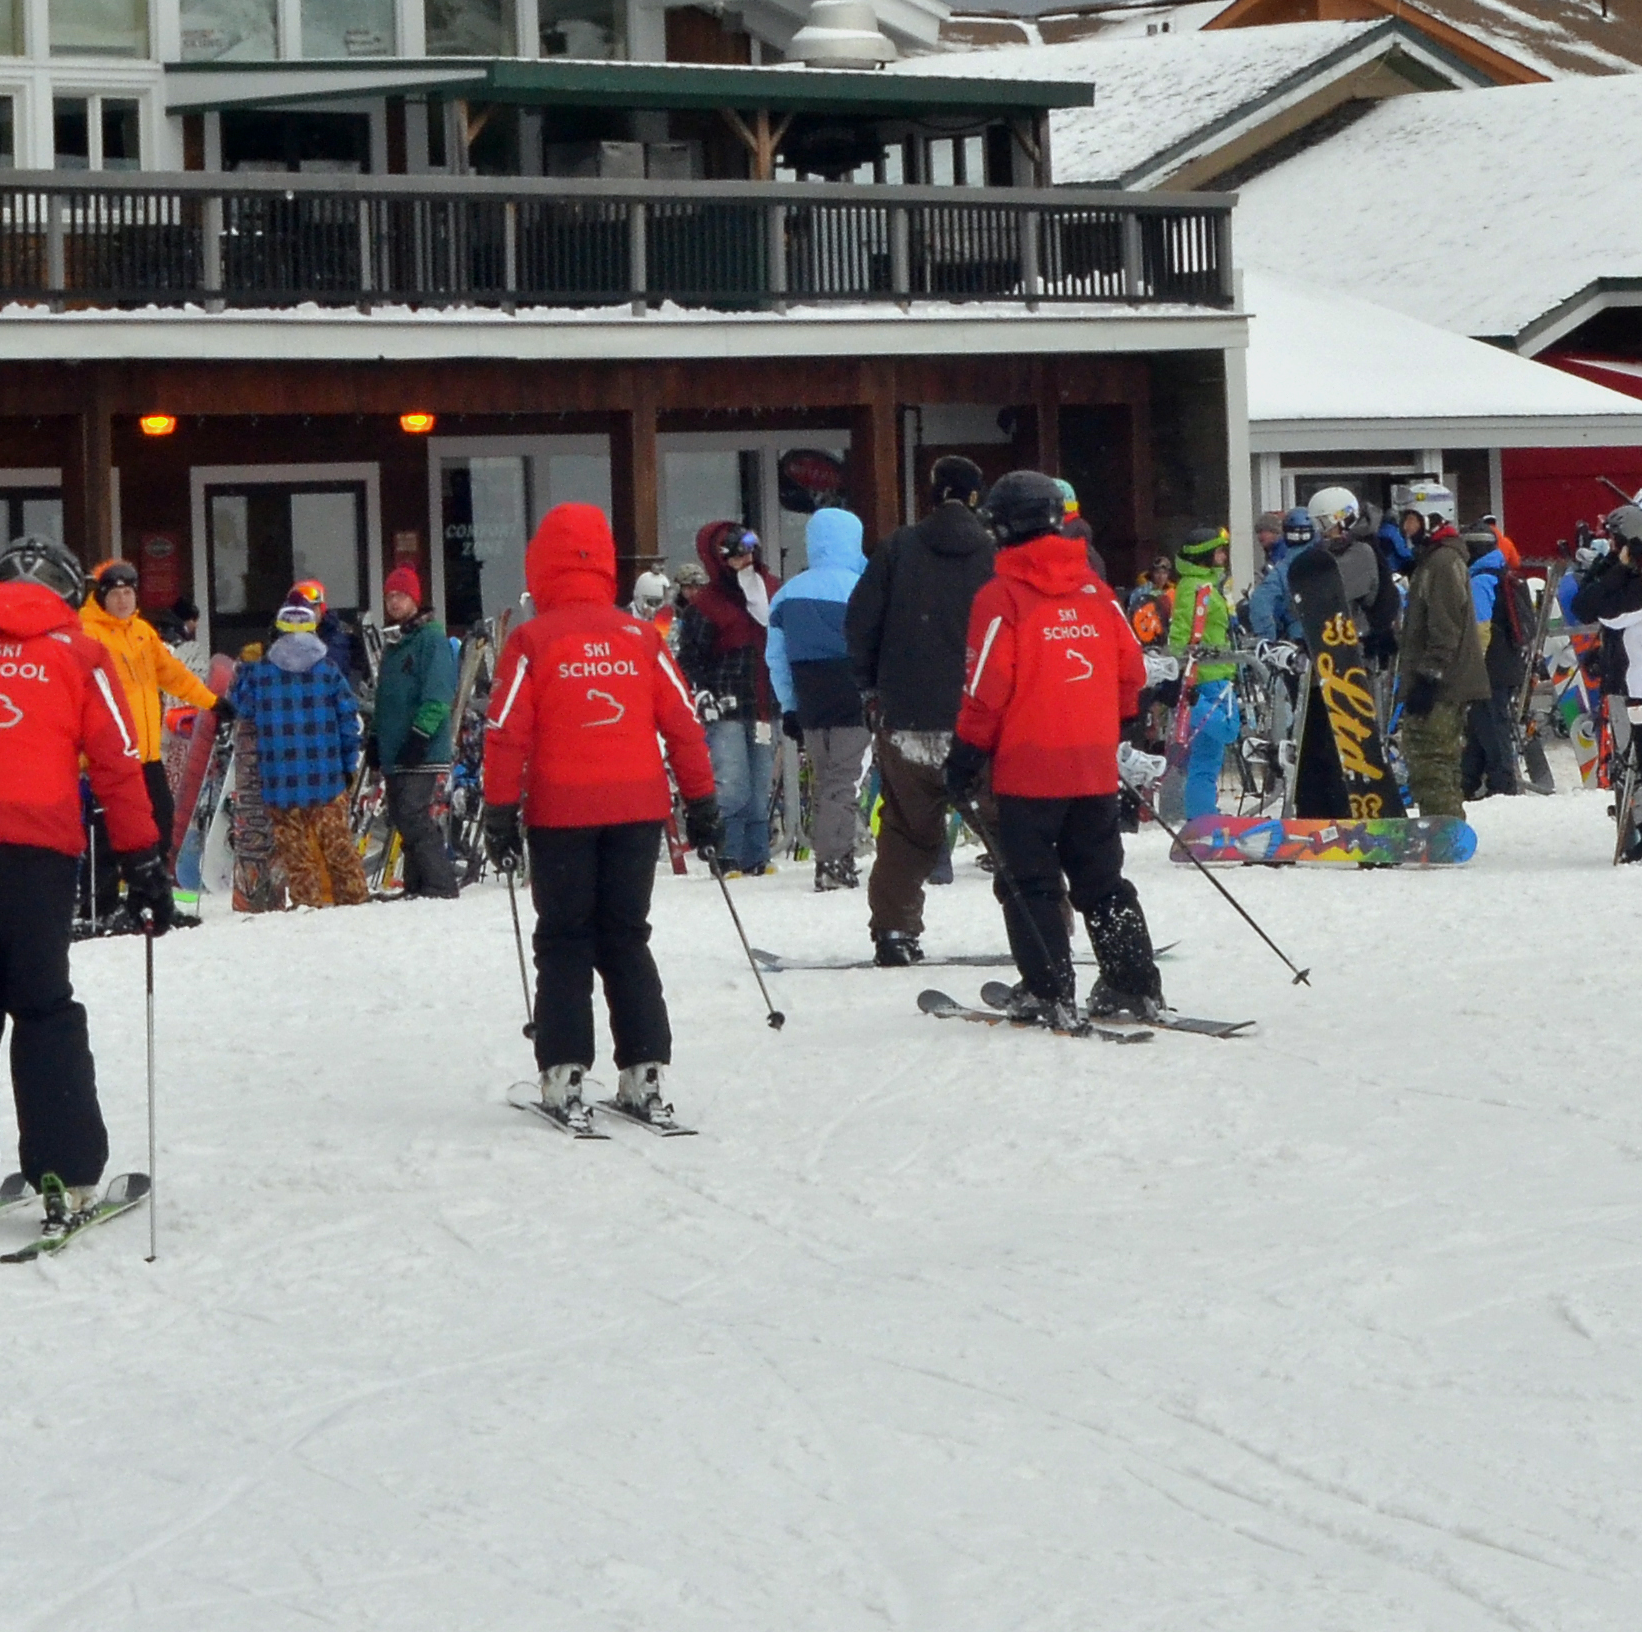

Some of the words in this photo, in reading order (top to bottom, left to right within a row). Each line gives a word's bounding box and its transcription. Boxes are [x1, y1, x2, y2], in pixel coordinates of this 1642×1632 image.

[1058, 608, 1078, 622] SKI
[1043, 624, 1099, 641] SCHOOL
[583, 641, 610, 658] SKI
[558, 659, 639, 679] SCHOOL
